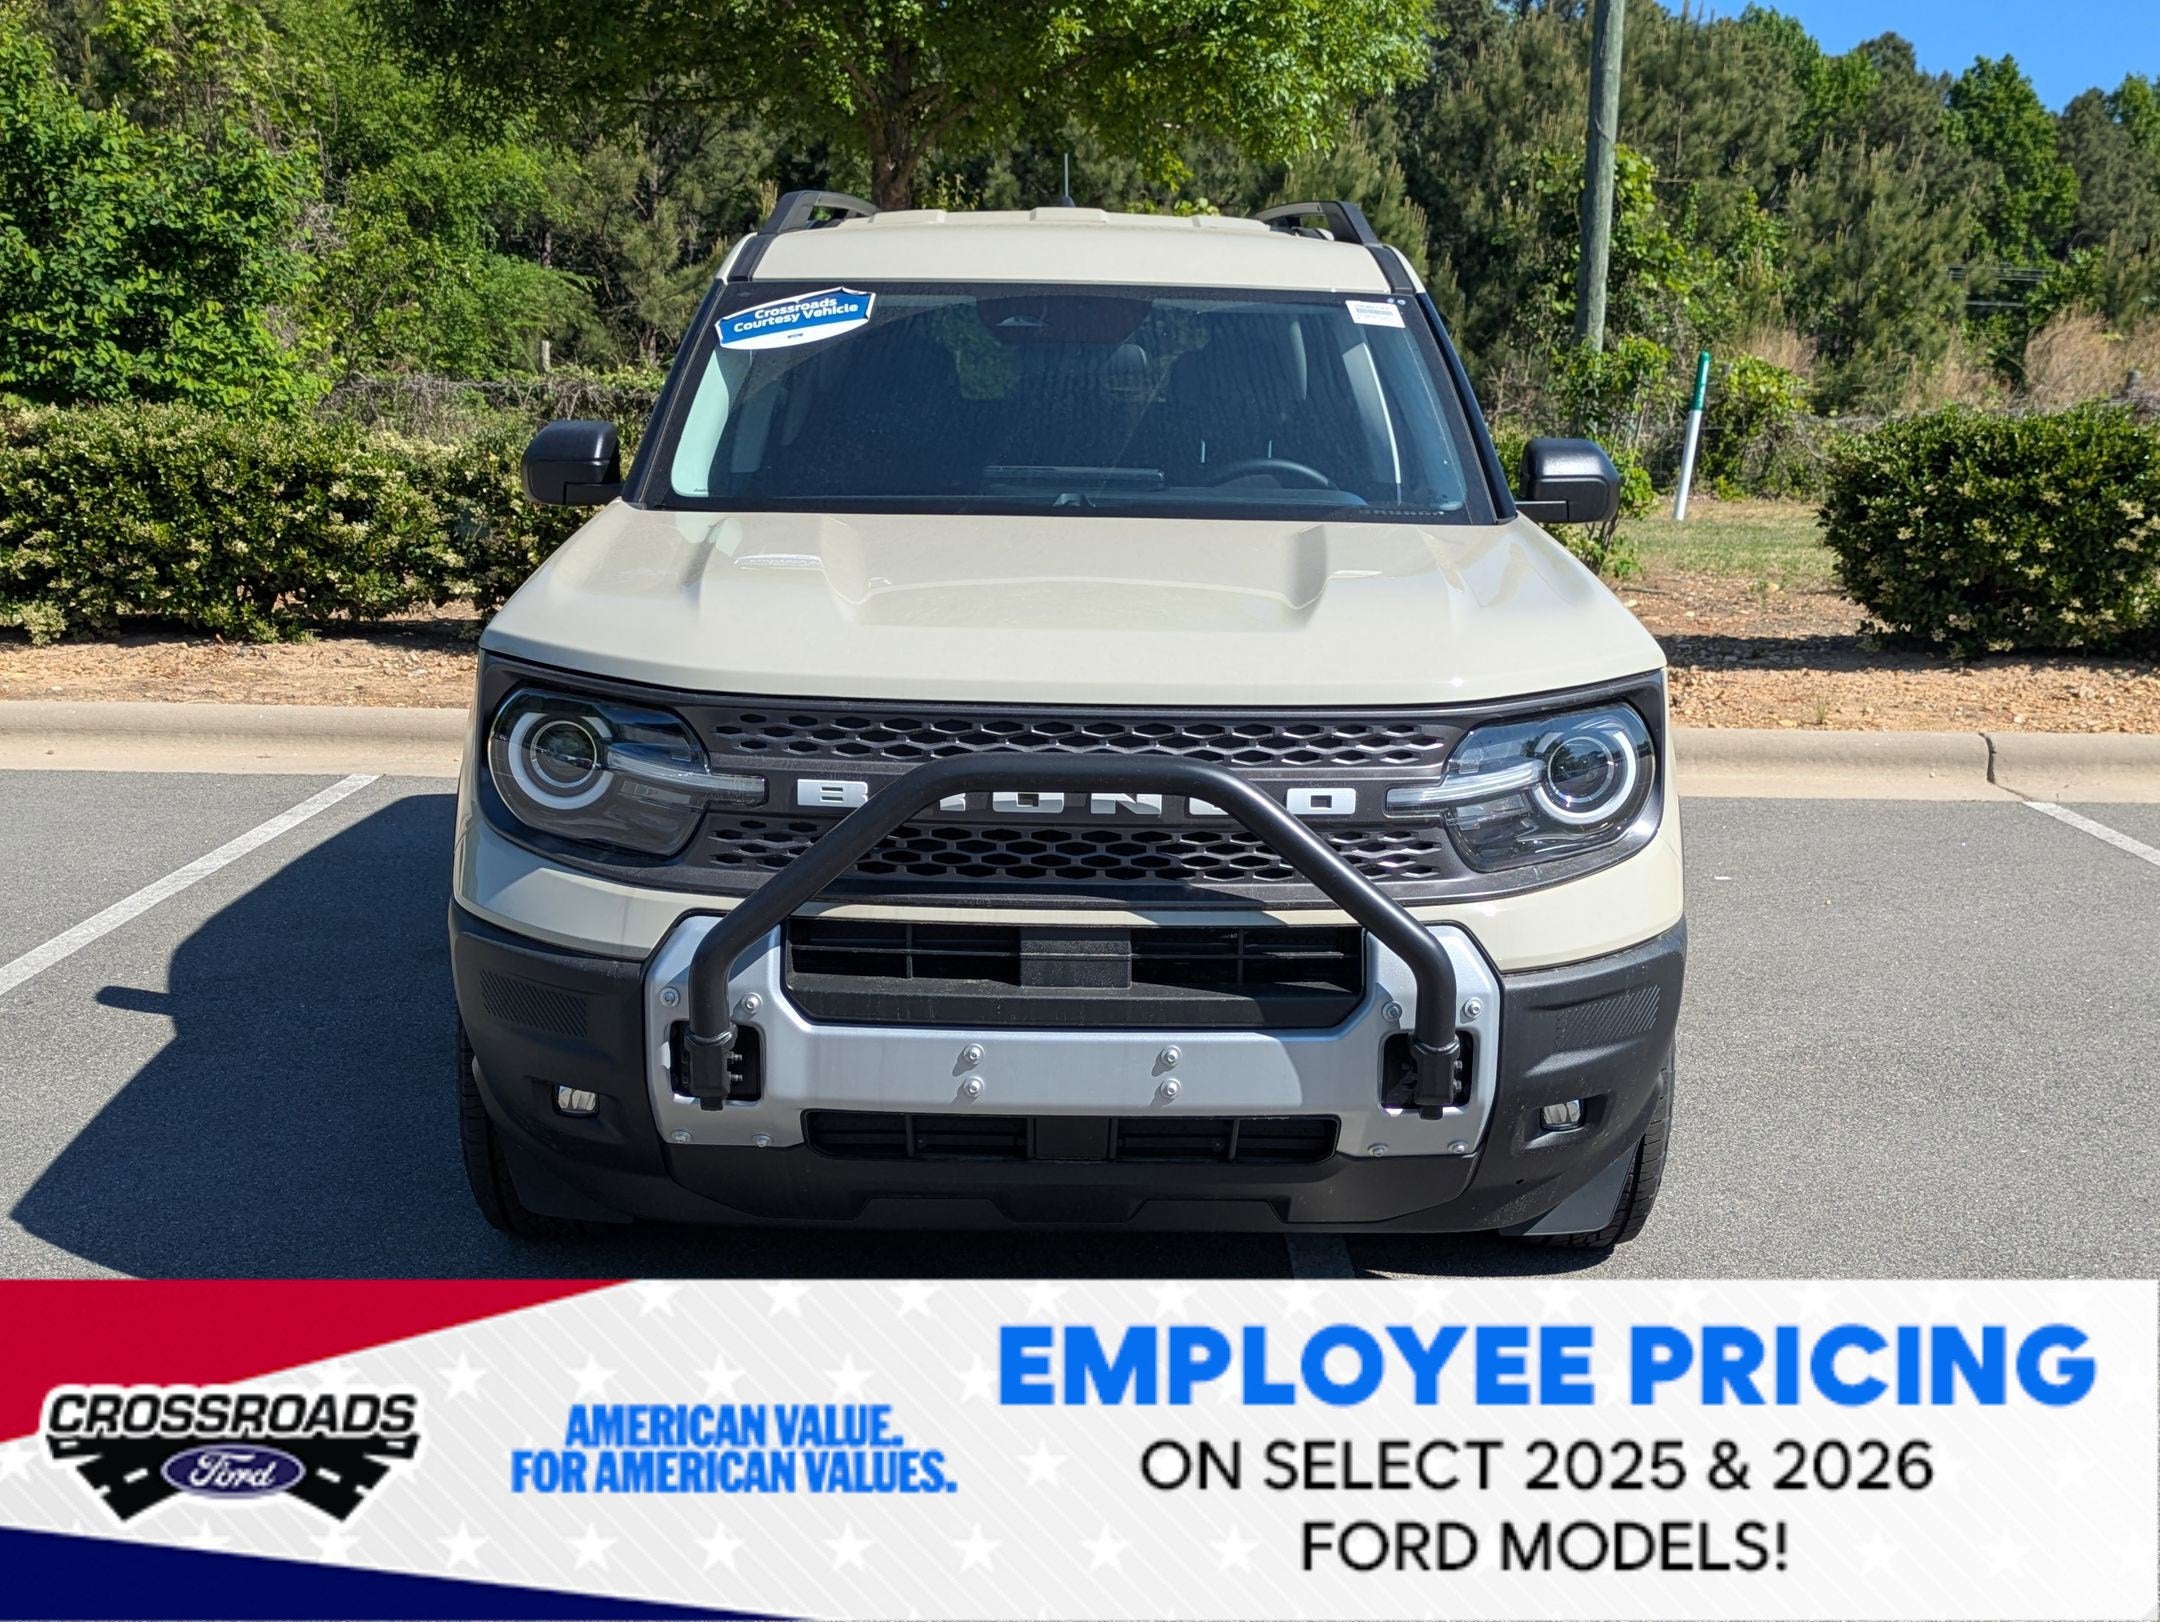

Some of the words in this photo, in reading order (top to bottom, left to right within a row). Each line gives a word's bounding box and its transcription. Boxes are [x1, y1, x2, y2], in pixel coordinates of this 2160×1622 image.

[733, 311, 801, 333] Courtesy
[803, 303, 859, 320] Vehicle
[754, 297, 837, 320] Crossroads
